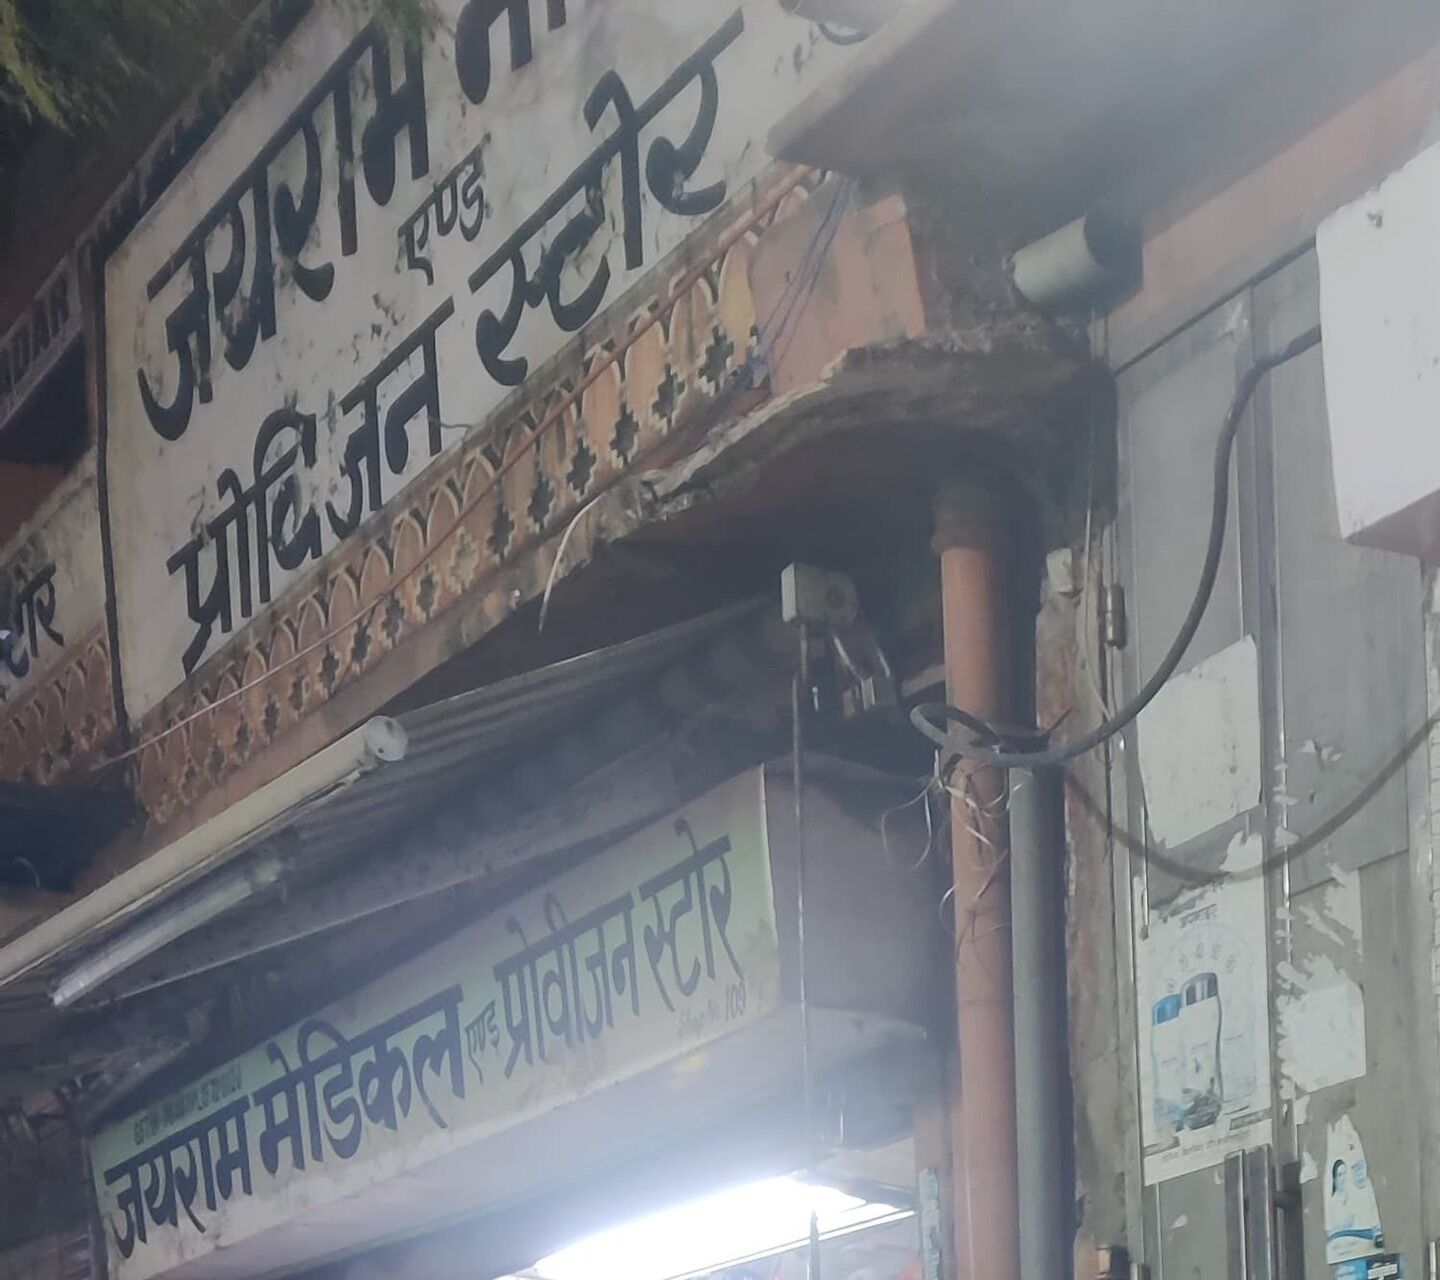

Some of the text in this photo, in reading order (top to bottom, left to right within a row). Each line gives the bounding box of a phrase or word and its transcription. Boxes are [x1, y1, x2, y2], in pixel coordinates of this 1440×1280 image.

[468, 6, 745, 386] स्टोर
[104, 1095, 252, 1259] जयराम
[252, 983, 465, 1176] मेडिकल
[493, 890, 640, 1079] प्रोवीजन
[637, 815, 744, 1012] स्टोर
